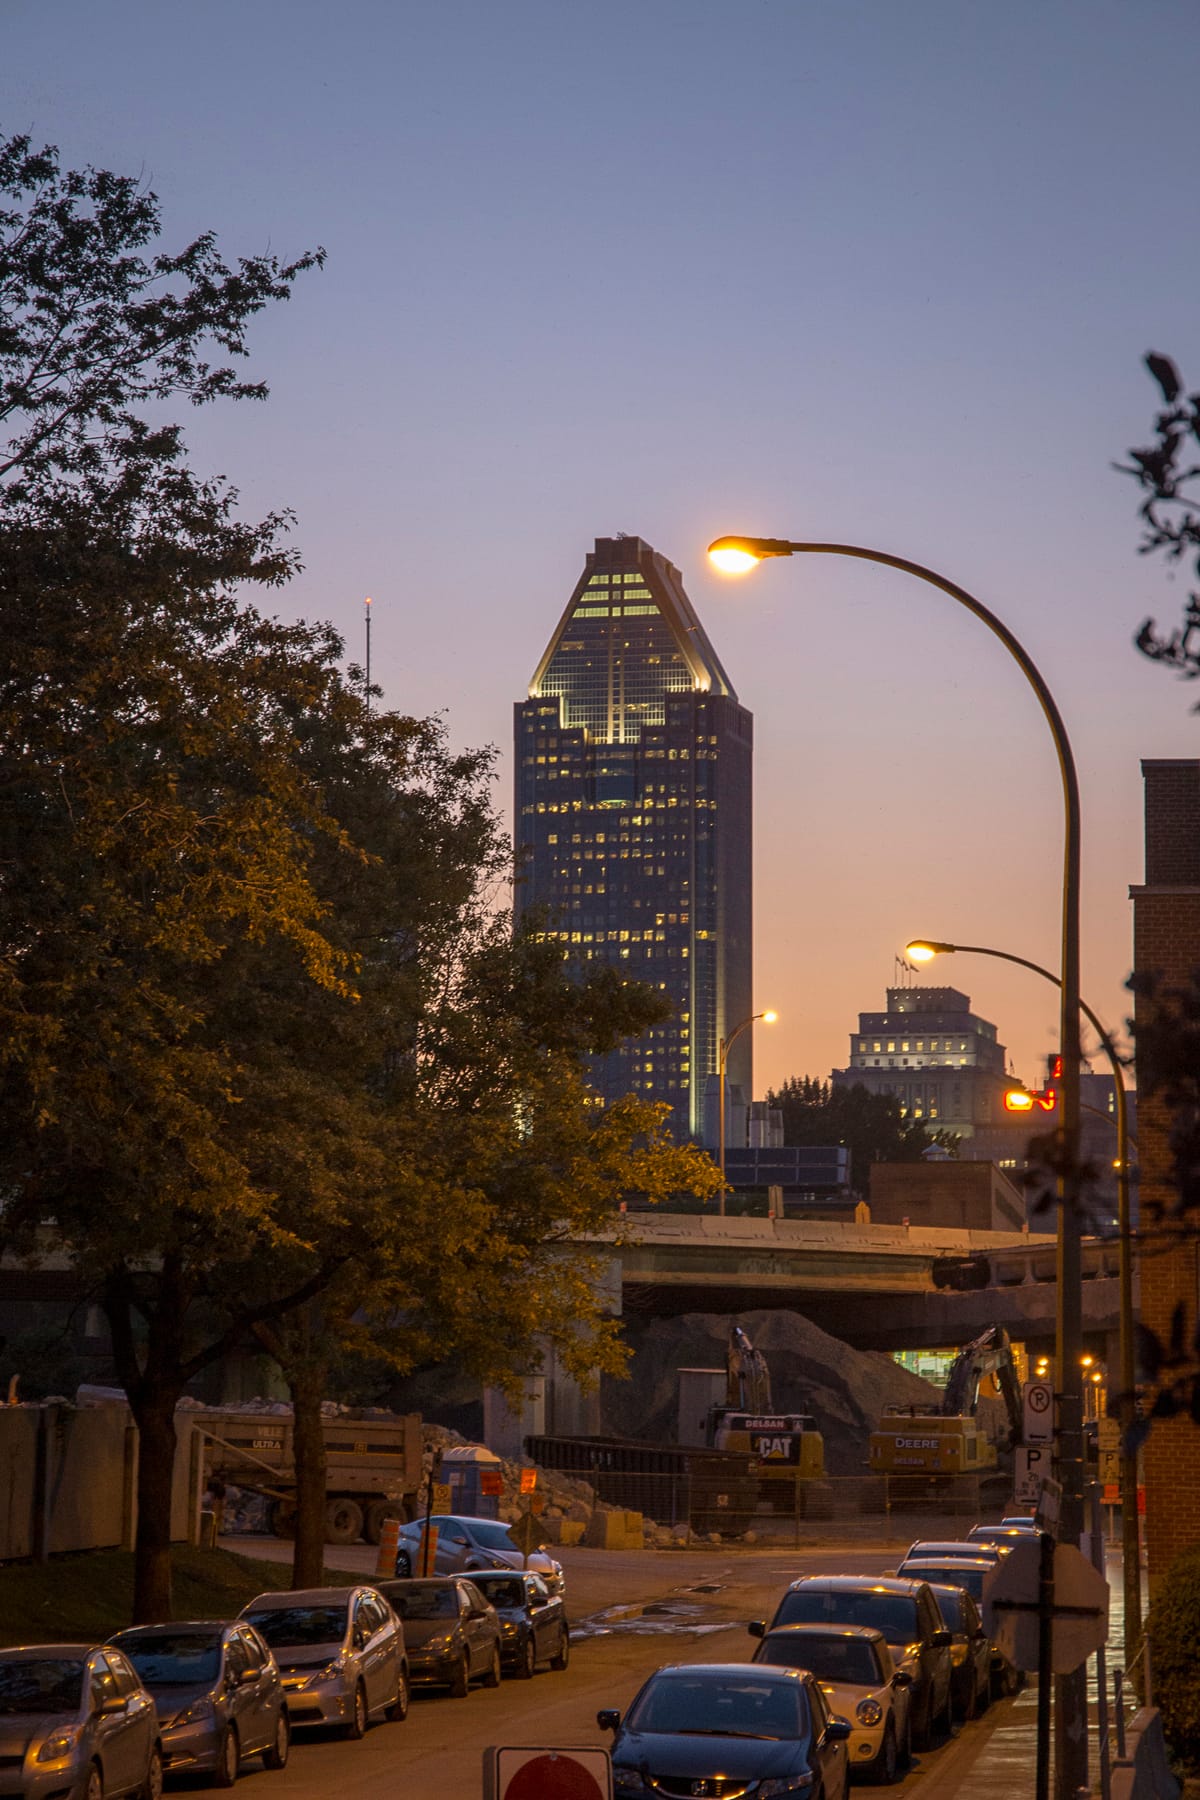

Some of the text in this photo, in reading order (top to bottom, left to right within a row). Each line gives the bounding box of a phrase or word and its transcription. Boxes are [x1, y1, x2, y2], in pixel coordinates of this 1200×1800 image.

[252, 1439, 281, 1449] ULTRA
[759, 1438, 792, 1459] CAT
[895, 1437, 939, 1449] DEERE
[1028, 1449, 1041, 1470] P
